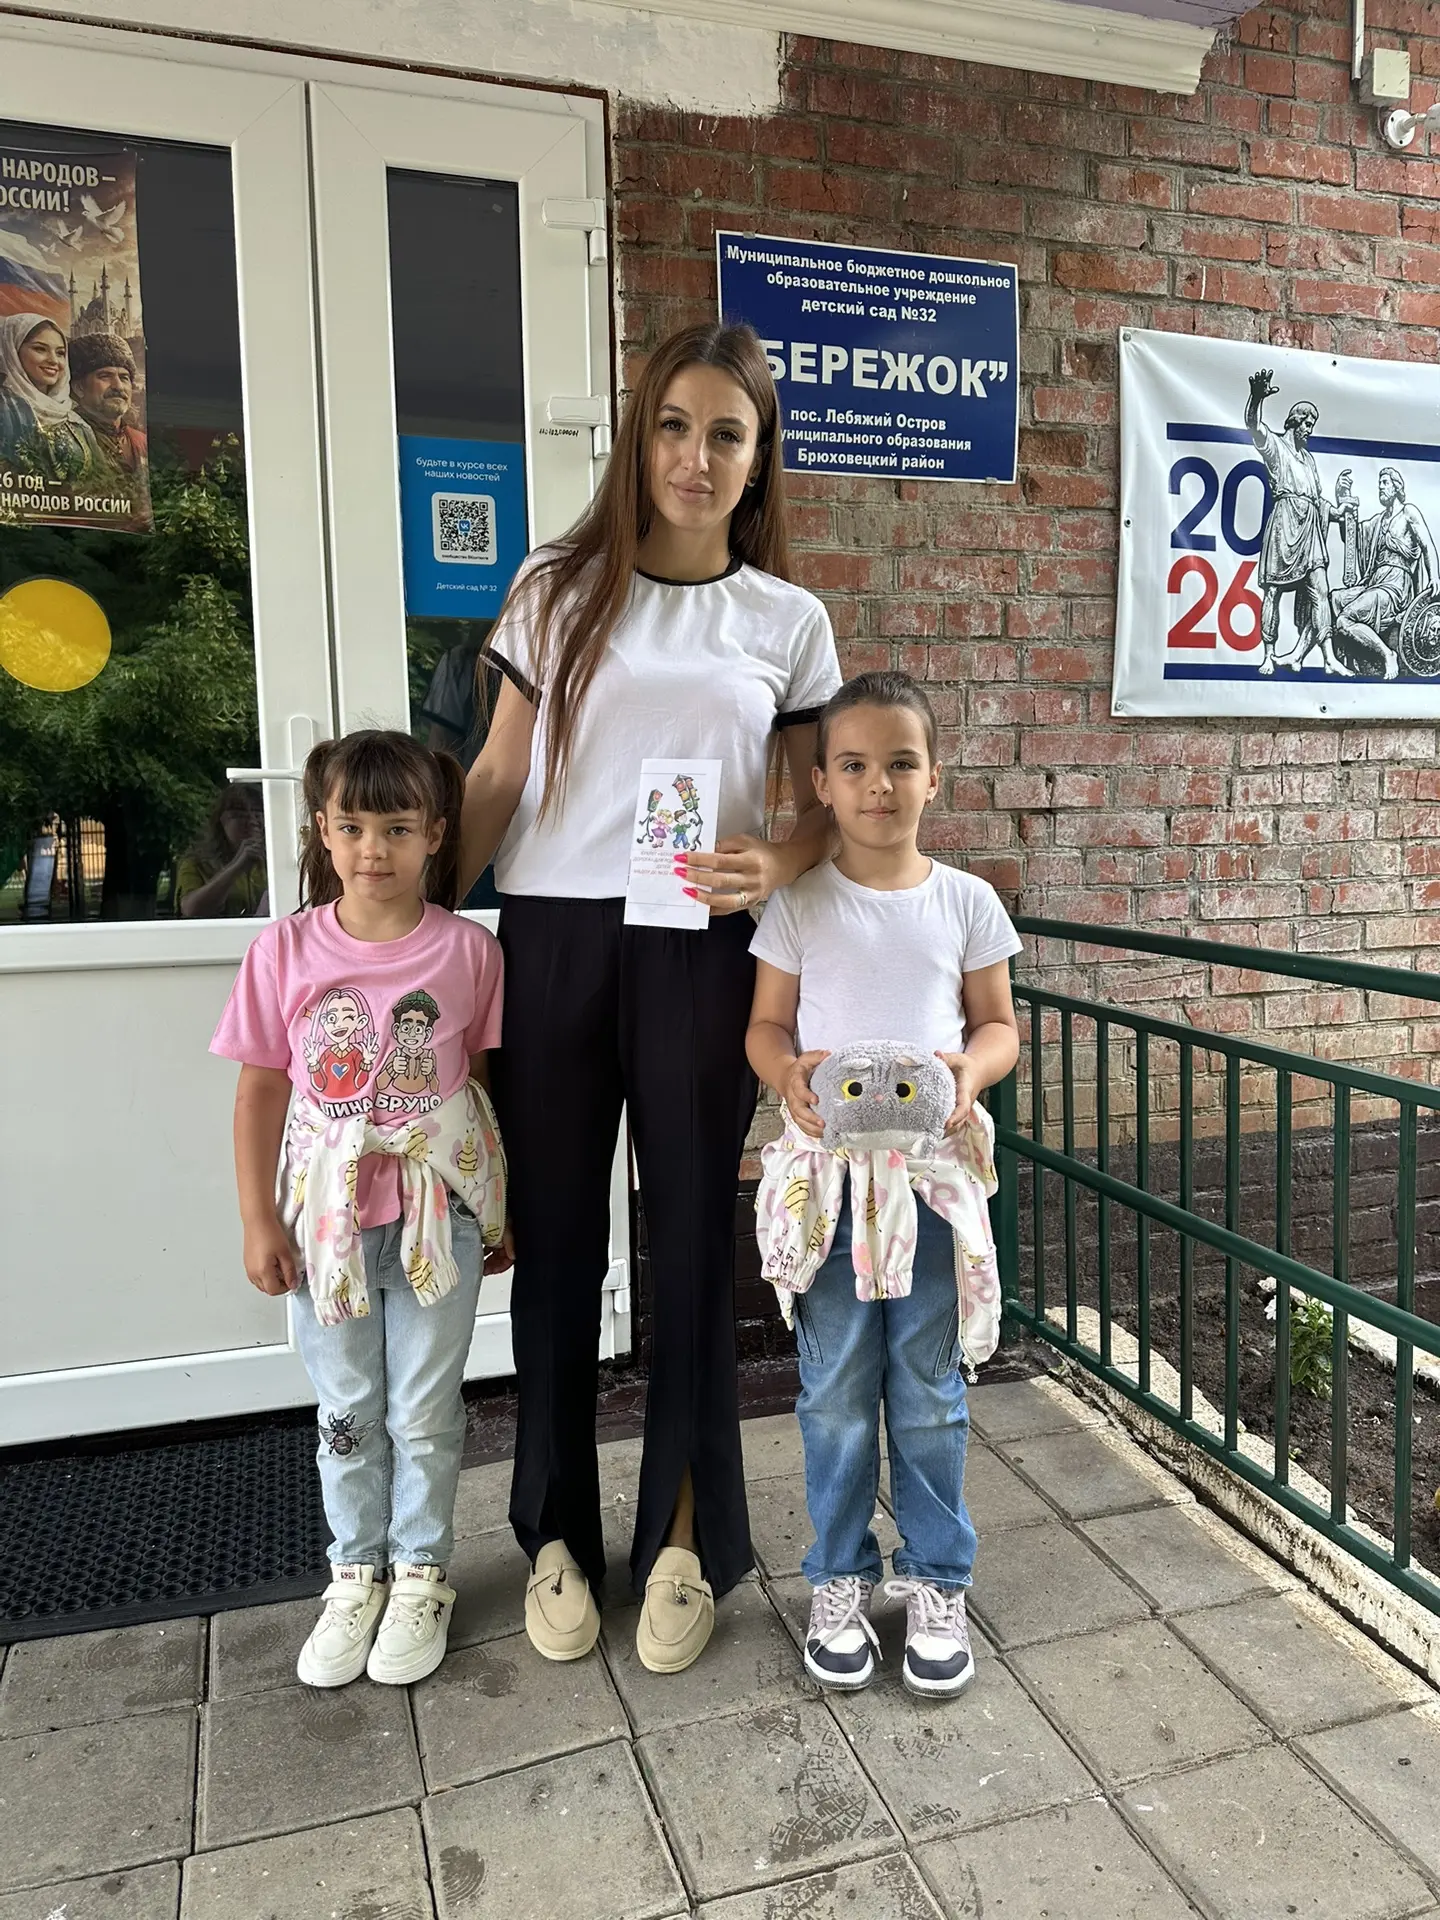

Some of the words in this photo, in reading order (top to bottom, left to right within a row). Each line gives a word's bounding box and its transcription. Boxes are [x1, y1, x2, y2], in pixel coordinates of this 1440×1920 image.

[0, 185, 70, 213] ОССИИ!
[726, 245, 843, 273] Муниципальное
[847, 259, 925, 281] бюджетное
[929, 270, 1011, 289] дошкольное
[766, 272, 890, 297] образовательное
[893, 287, 977, 305] учреждение
[801, 299, 865, 316] детский
[869, 306, 897, 321] сад
[901, 307, 937, 322] №32
[790, 409, 822, 423] пос.
[825, 408, 892, 427] Лебяжий
[896, 413, 947, 433] Остров
[780, 428, 883, 446] униципального
[886, 433, 971, 450] образования
[415, 456, 448, 468] будьте
[449, 460, 455, 468] в
[456, 461, 485, 471] курсе
[486, 463, 508, 472] всех
[797, 447, 898, 467] Брюховецкий
[901, 454, 945, 470] район
[424, 470, 455, 479] наших
[456, 472, 500, 482] новостей
[1, 492, 71, 512] НАРОДОВ
[74, 495, 131, 514] РОССИИ
[1168, 456, 1272, 556] 20
[435, 582, 466, 591] Детский
[1166, 555, 1265, 652] 26
[374, 1091, 443, 1113] БРУНО
